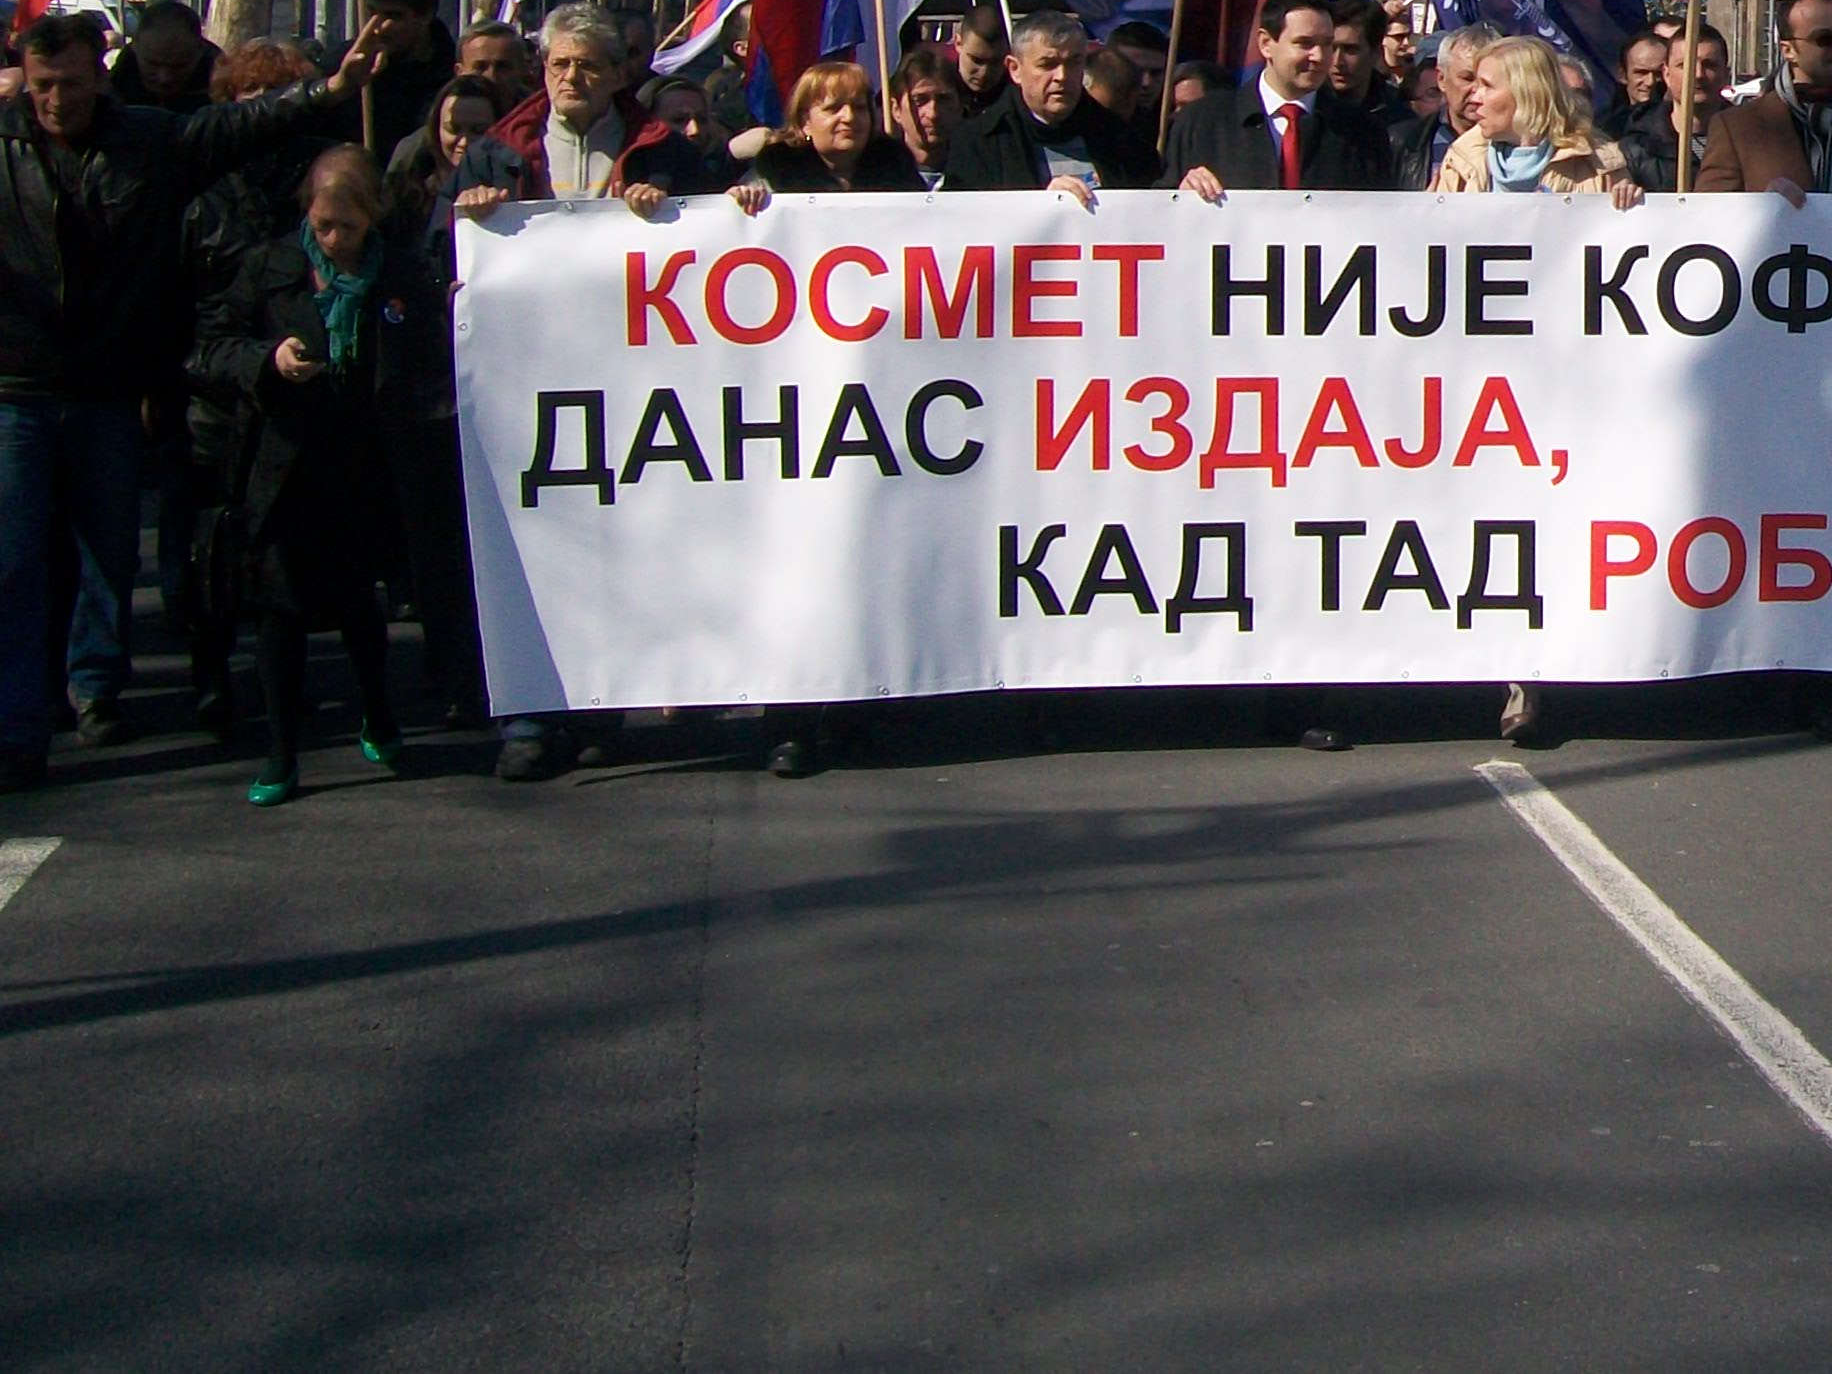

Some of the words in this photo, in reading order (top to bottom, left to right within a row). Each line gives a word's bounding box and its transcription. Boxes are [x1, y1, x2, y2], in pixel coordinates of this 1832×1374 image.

[624, 243, 1165, 346] КОСМЕТ
[1211, 243, 1534, 338] НИЈЕ
[520, 378, 985, 509] ДАНАС
[1035, 375, 1570, 490] ИЗДАЈА,
[999, 521, 1255, 633] КАД
[1294, 518, 1544, 630] ТАД
